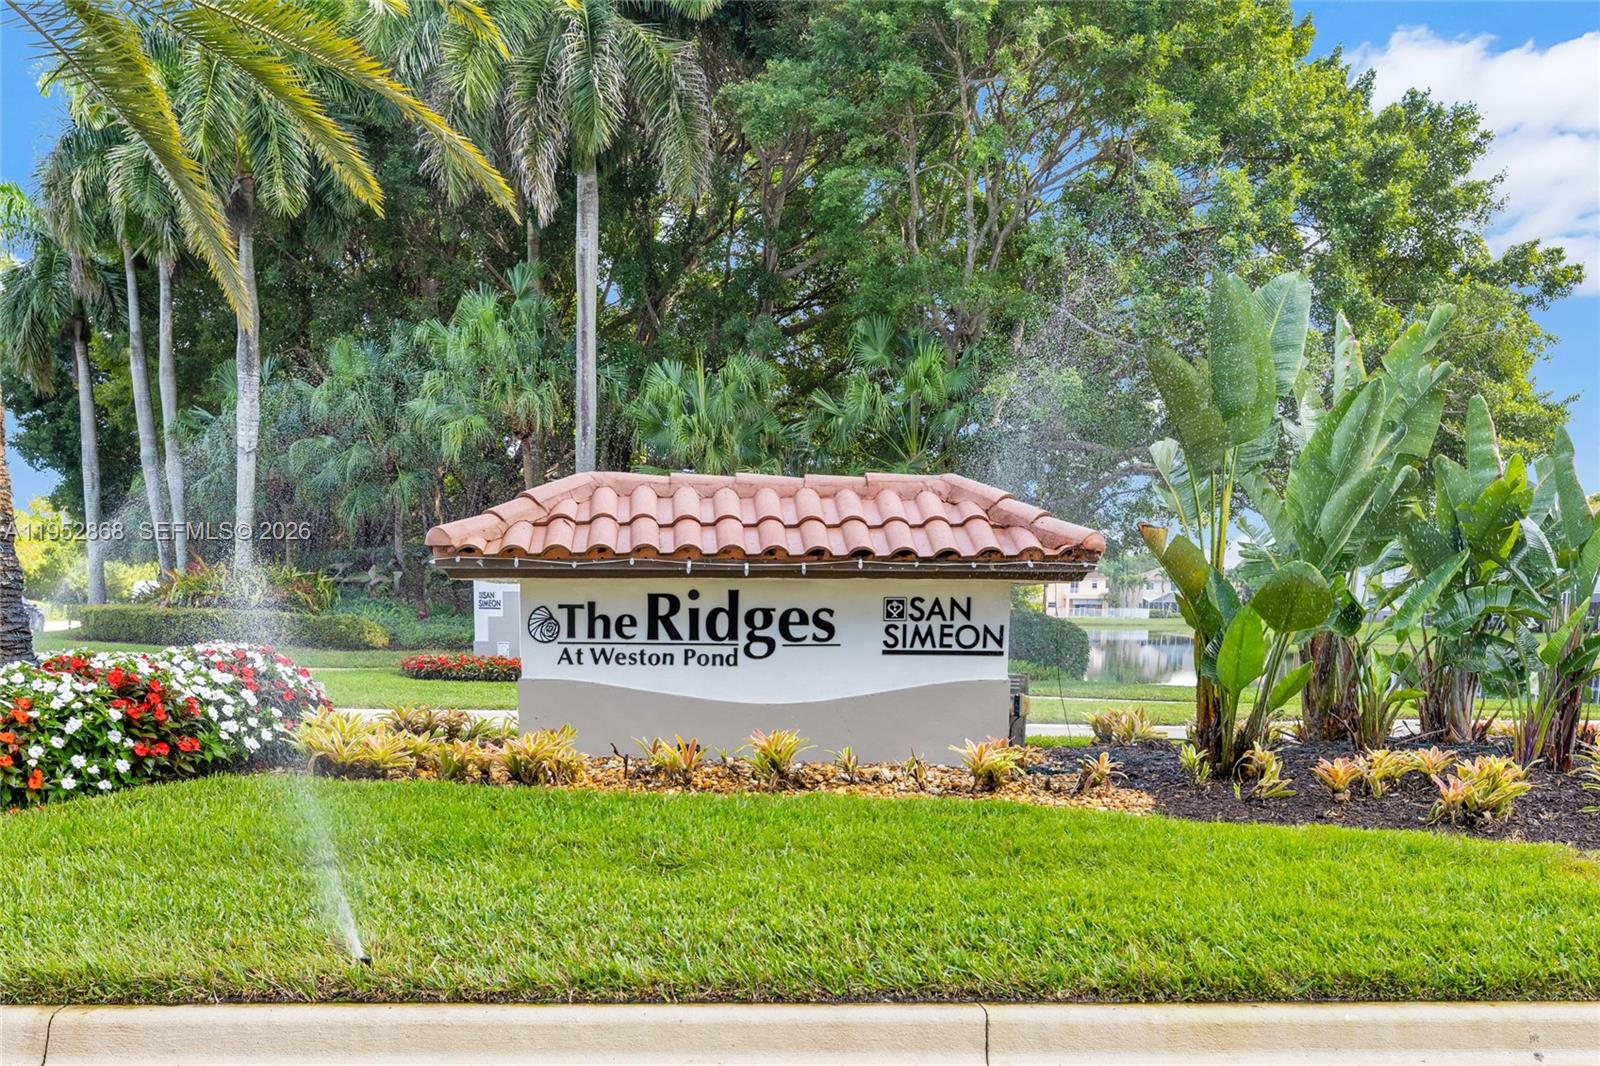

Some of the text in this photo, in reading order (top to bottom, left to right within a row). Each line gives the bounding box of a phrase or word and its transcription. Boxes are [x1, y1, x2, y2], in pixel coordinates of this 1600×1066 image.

[478, 599, 502, 607] SIMEON
[908, 596, 972, 622] SAN
[557, 588, 837, 660] The Ridges
[882, 623, 1005, 650] SIMEON
[557, 647, 739, 668] At Weston Pond
